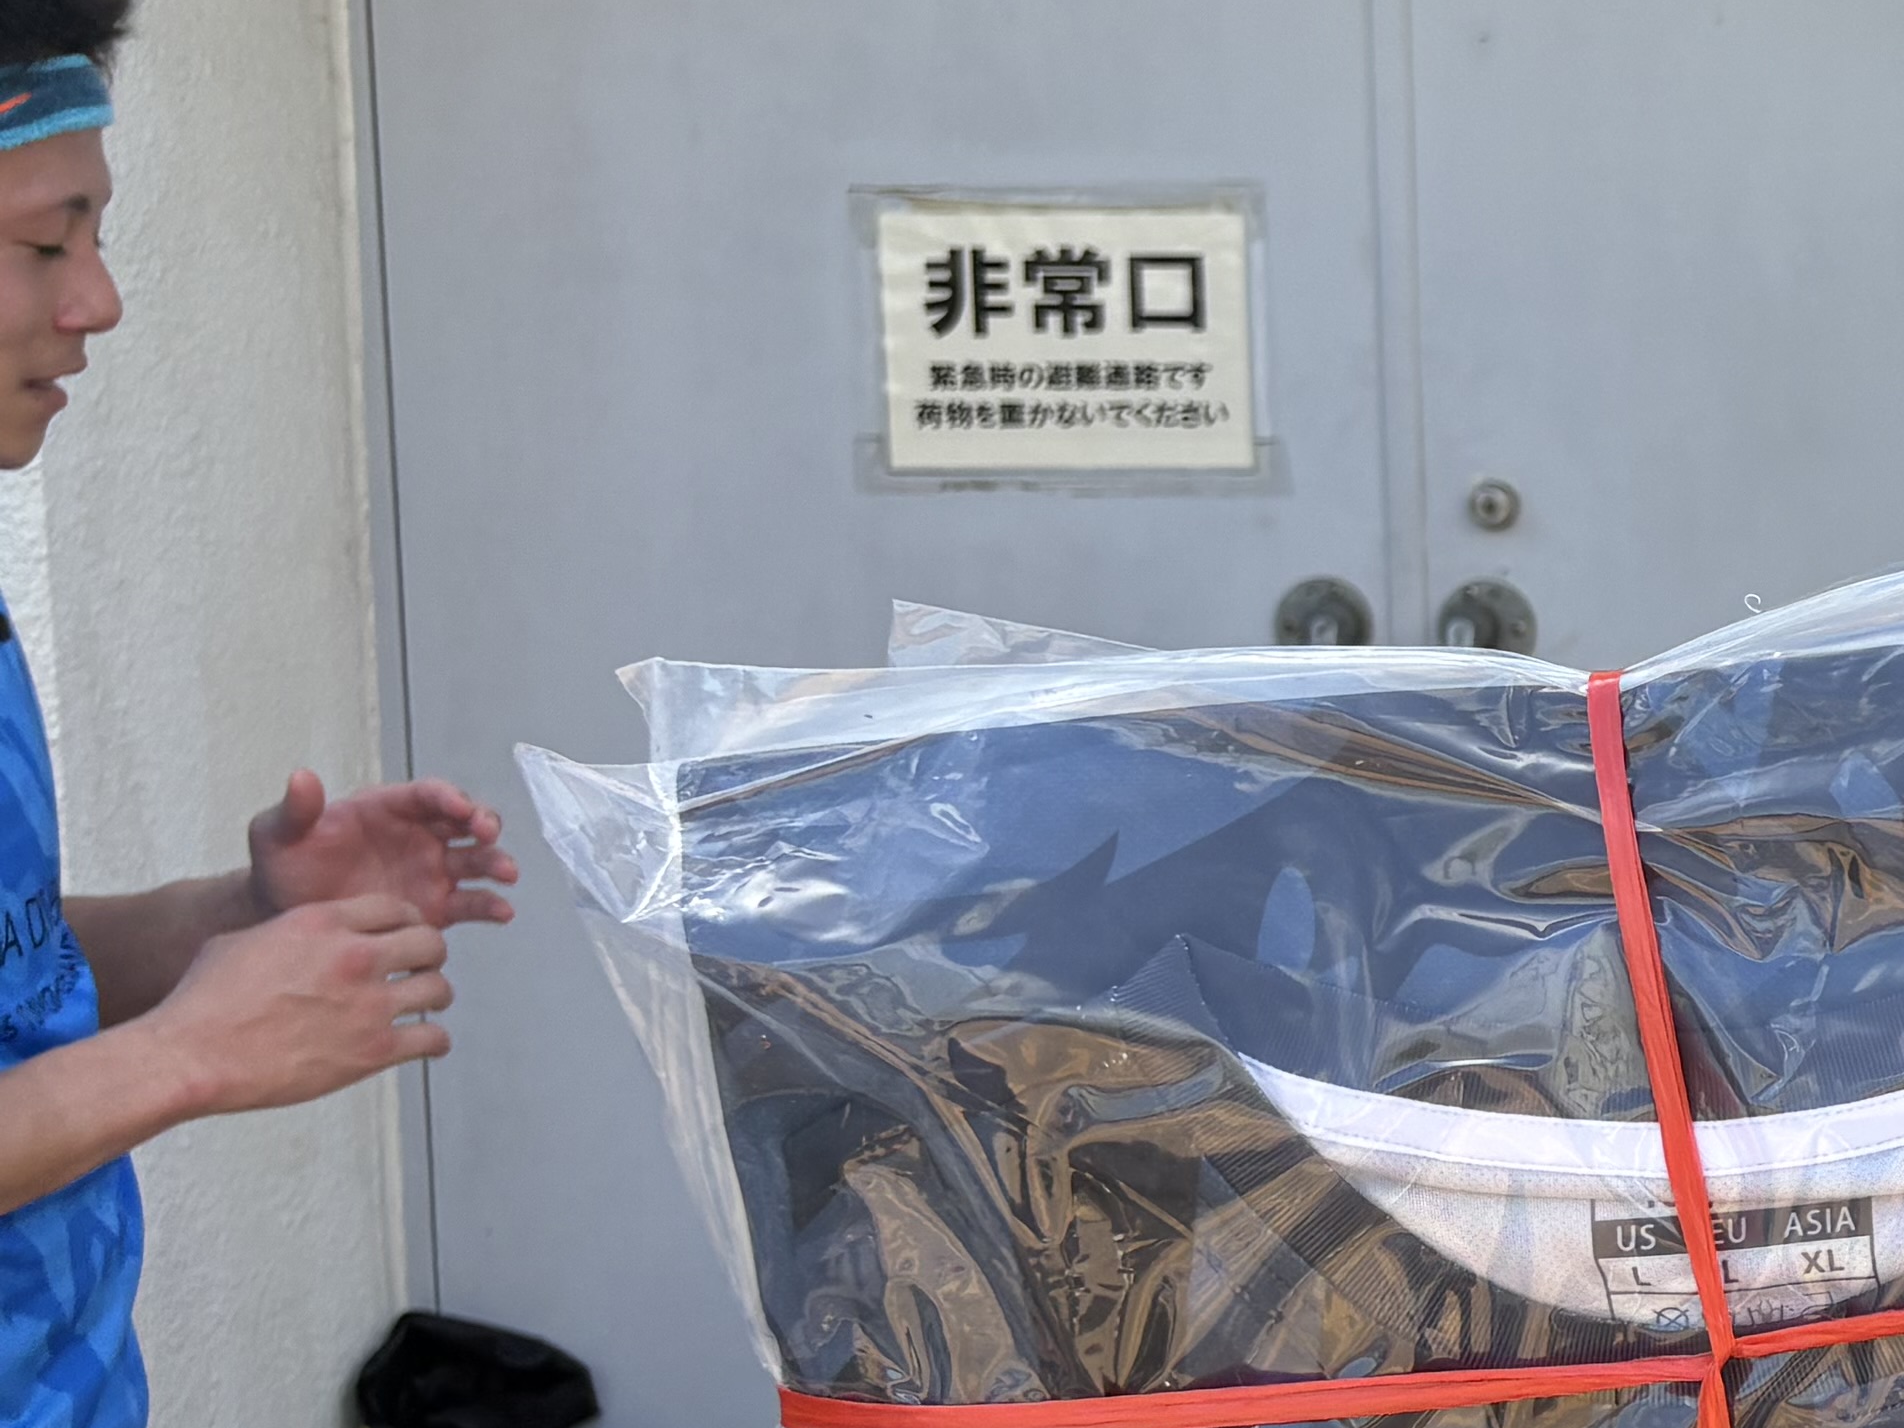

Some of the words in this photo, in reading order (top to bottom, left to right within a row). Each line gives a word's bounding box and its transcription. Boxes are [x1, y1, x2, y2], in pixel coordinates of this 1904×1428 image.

[924, 245, 1208, 339] 非常口
[1616, 1223, 1656, 1252] US
[1783, 1205, 1856, 1239] ASIA
[1632, 1266, 1651, 1287] L
[1722, 1259, 1739, 1284] L
[1801, 1248, 1846, 1274] XL
